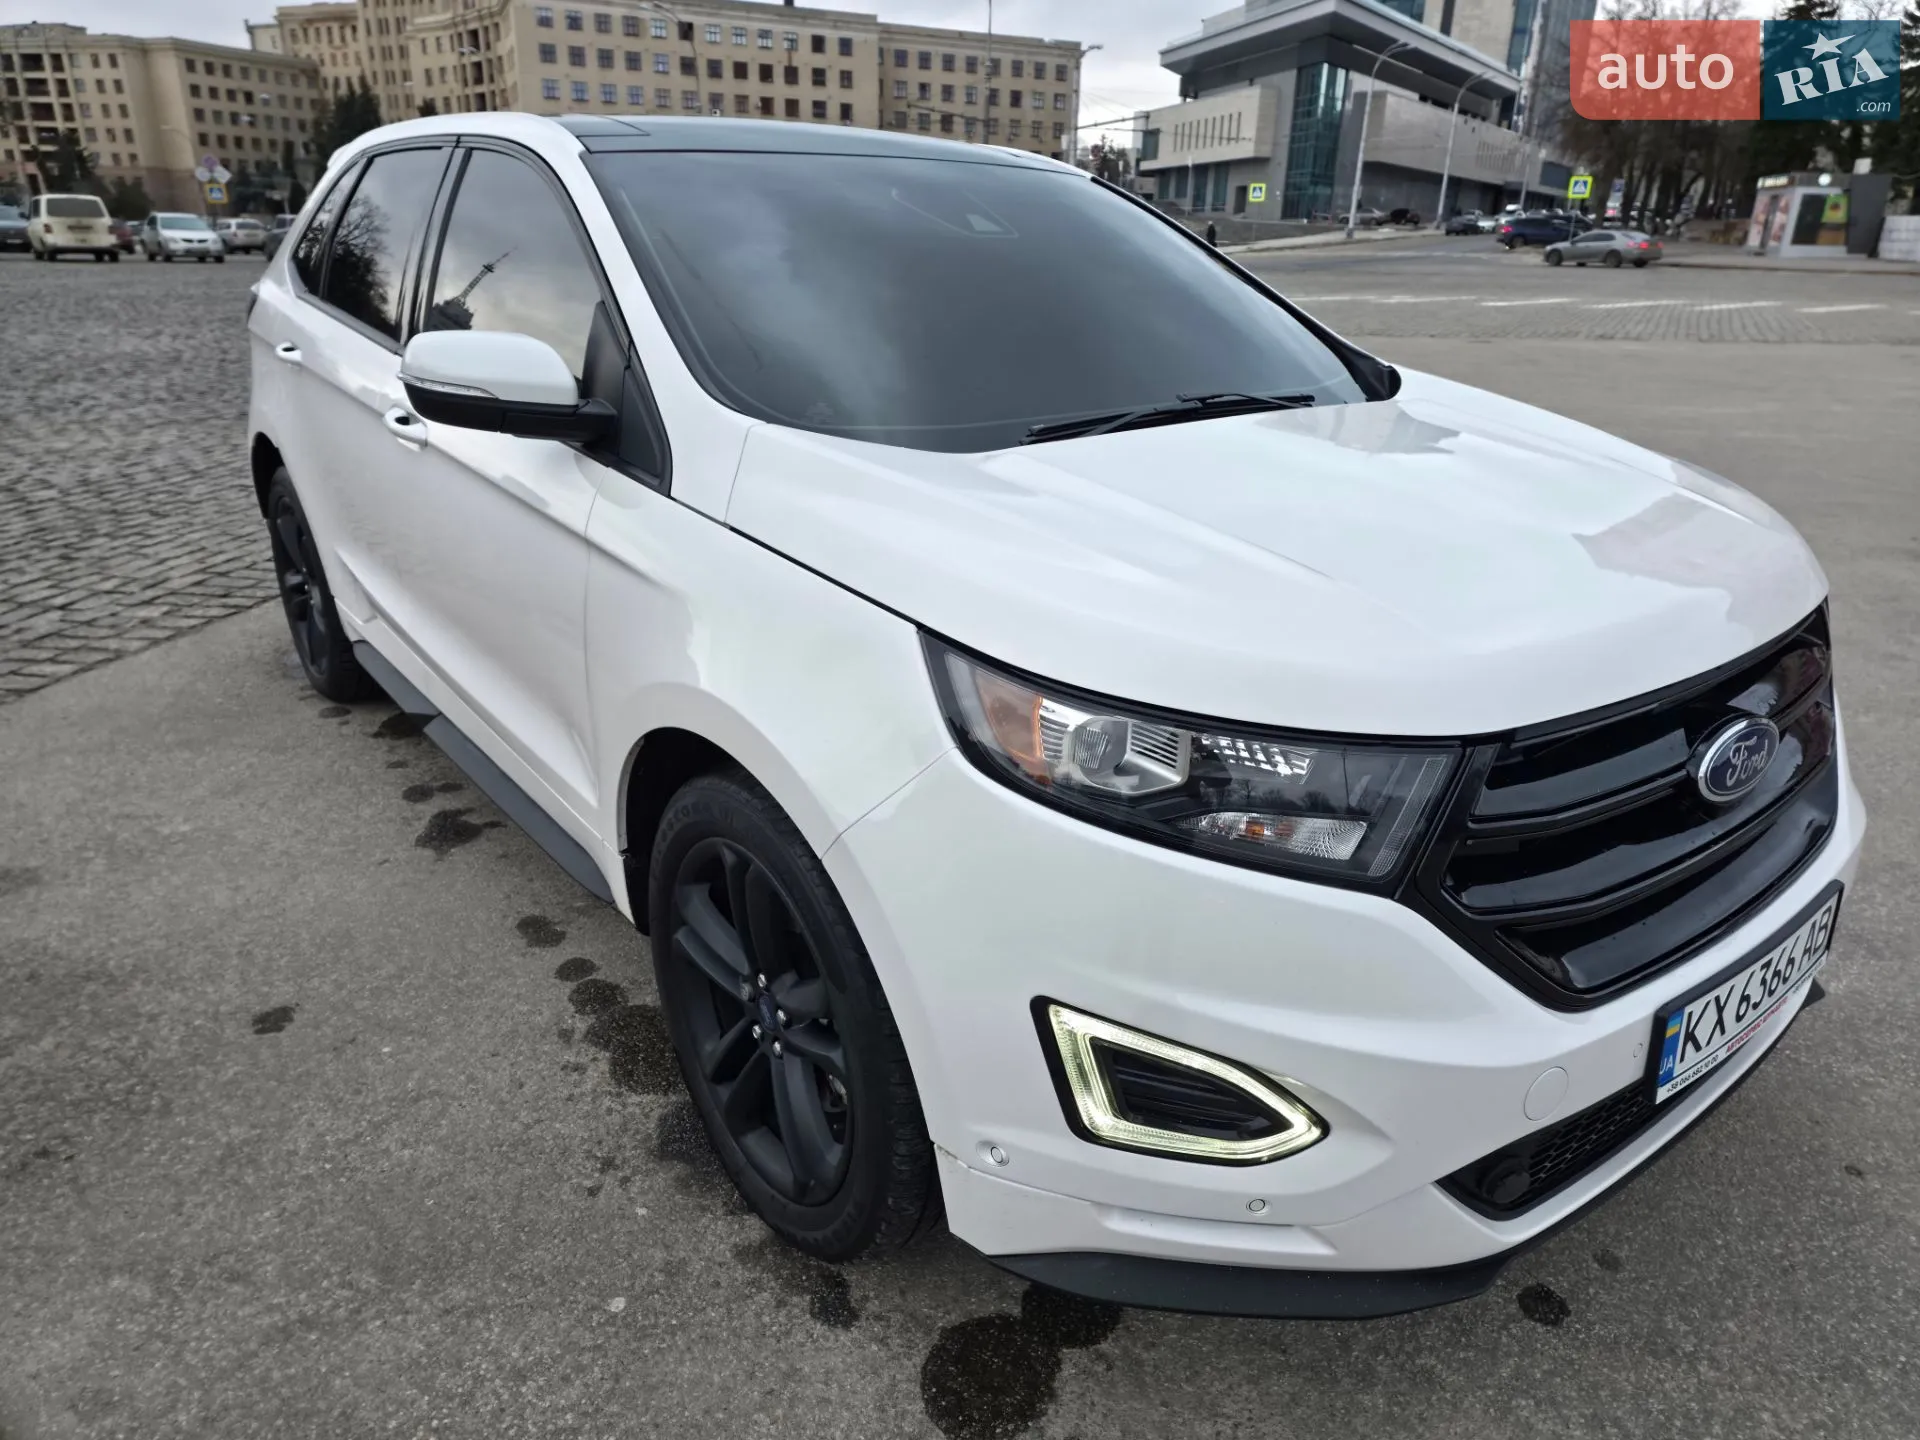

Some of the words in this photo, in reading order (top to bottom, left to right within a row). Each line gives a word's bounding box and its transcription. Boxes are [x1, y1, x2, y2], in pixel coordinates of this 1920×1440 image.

[1727, 735, 1769, 787] Ford
[1679, 984, 1735, 1064] KX
[1735, 935, 1800, 1023] 6366
[1797, 905, 1832, 973] AB
[1659, 1055, 1673, 1074] UA
